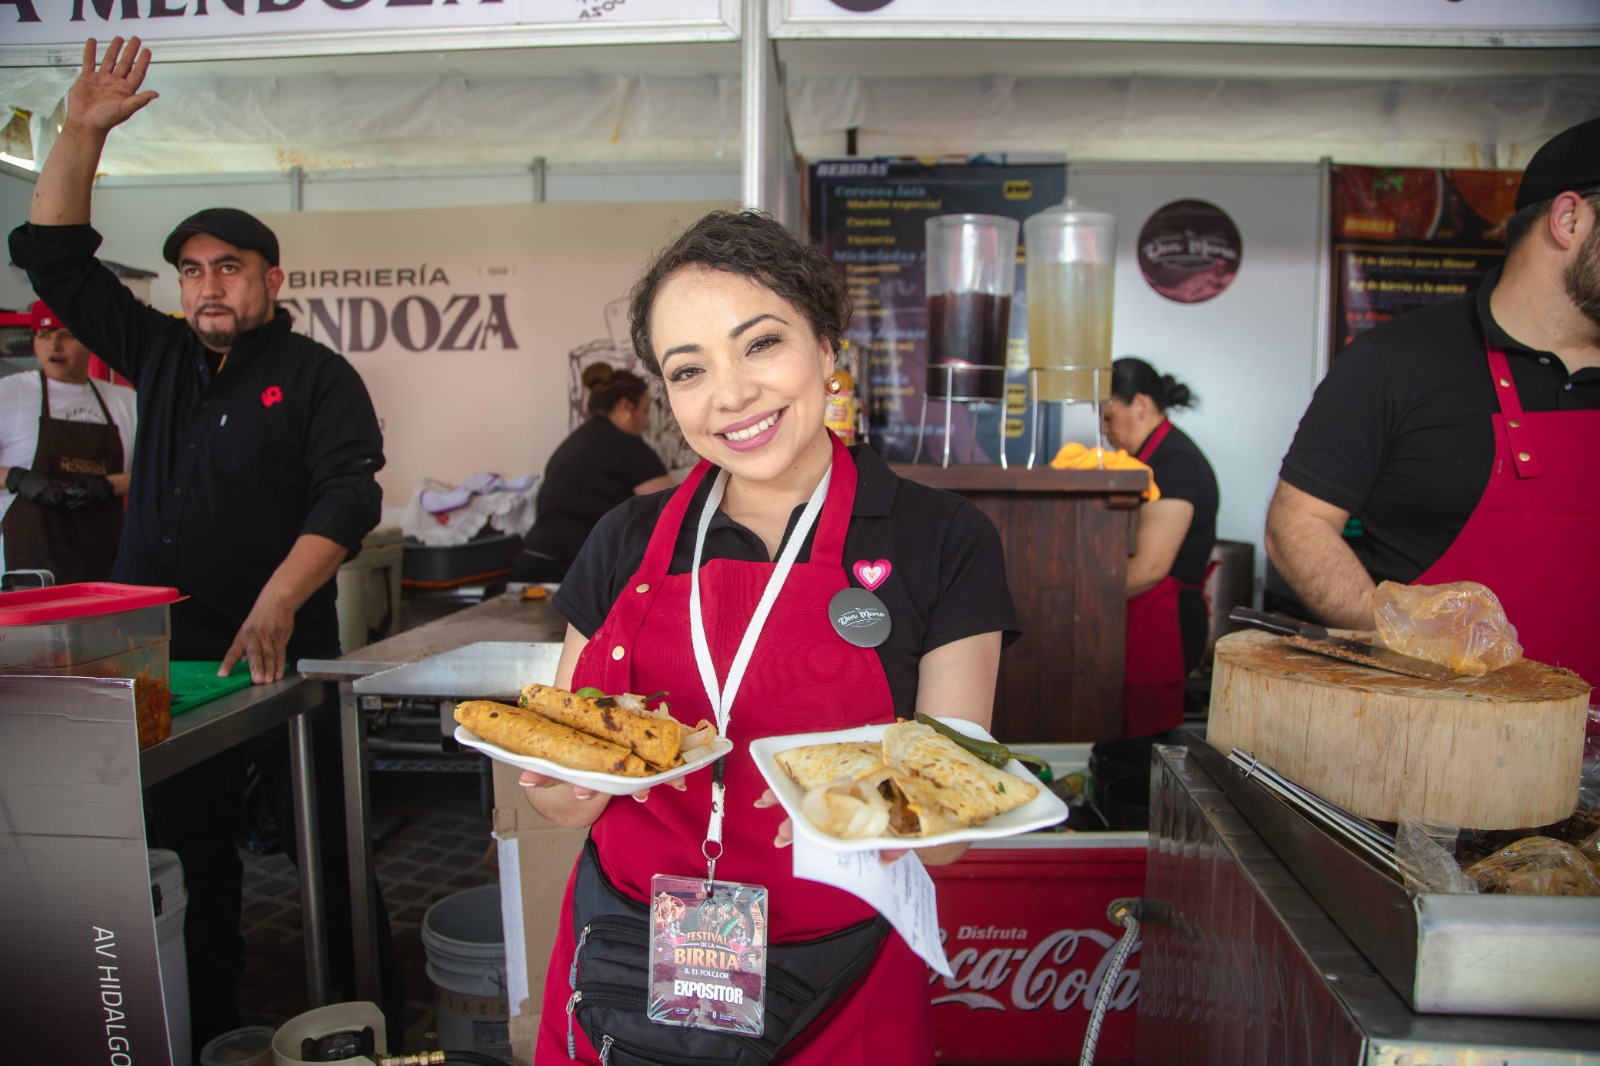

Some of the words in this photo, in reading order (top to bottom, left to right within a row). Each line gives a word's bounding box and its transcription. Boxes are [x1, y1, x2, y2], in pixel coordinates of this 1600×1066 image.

[288, 263, 449, 288] BIRRIERÍA
[92, 925, 117, 959] AV
[686, 931, 728, 945] FESTIVAL
[957, 925, 1028, 940] Disfruta
[673, 948, 740, 971] BIRRIA
[692, 968, 699, 976] EL
[700, 970, 730, 980] FOLCLOR
[673, 979, 744, 1005] EXPOSITOR
[97, 965, 132, 1066] HIDALGO
